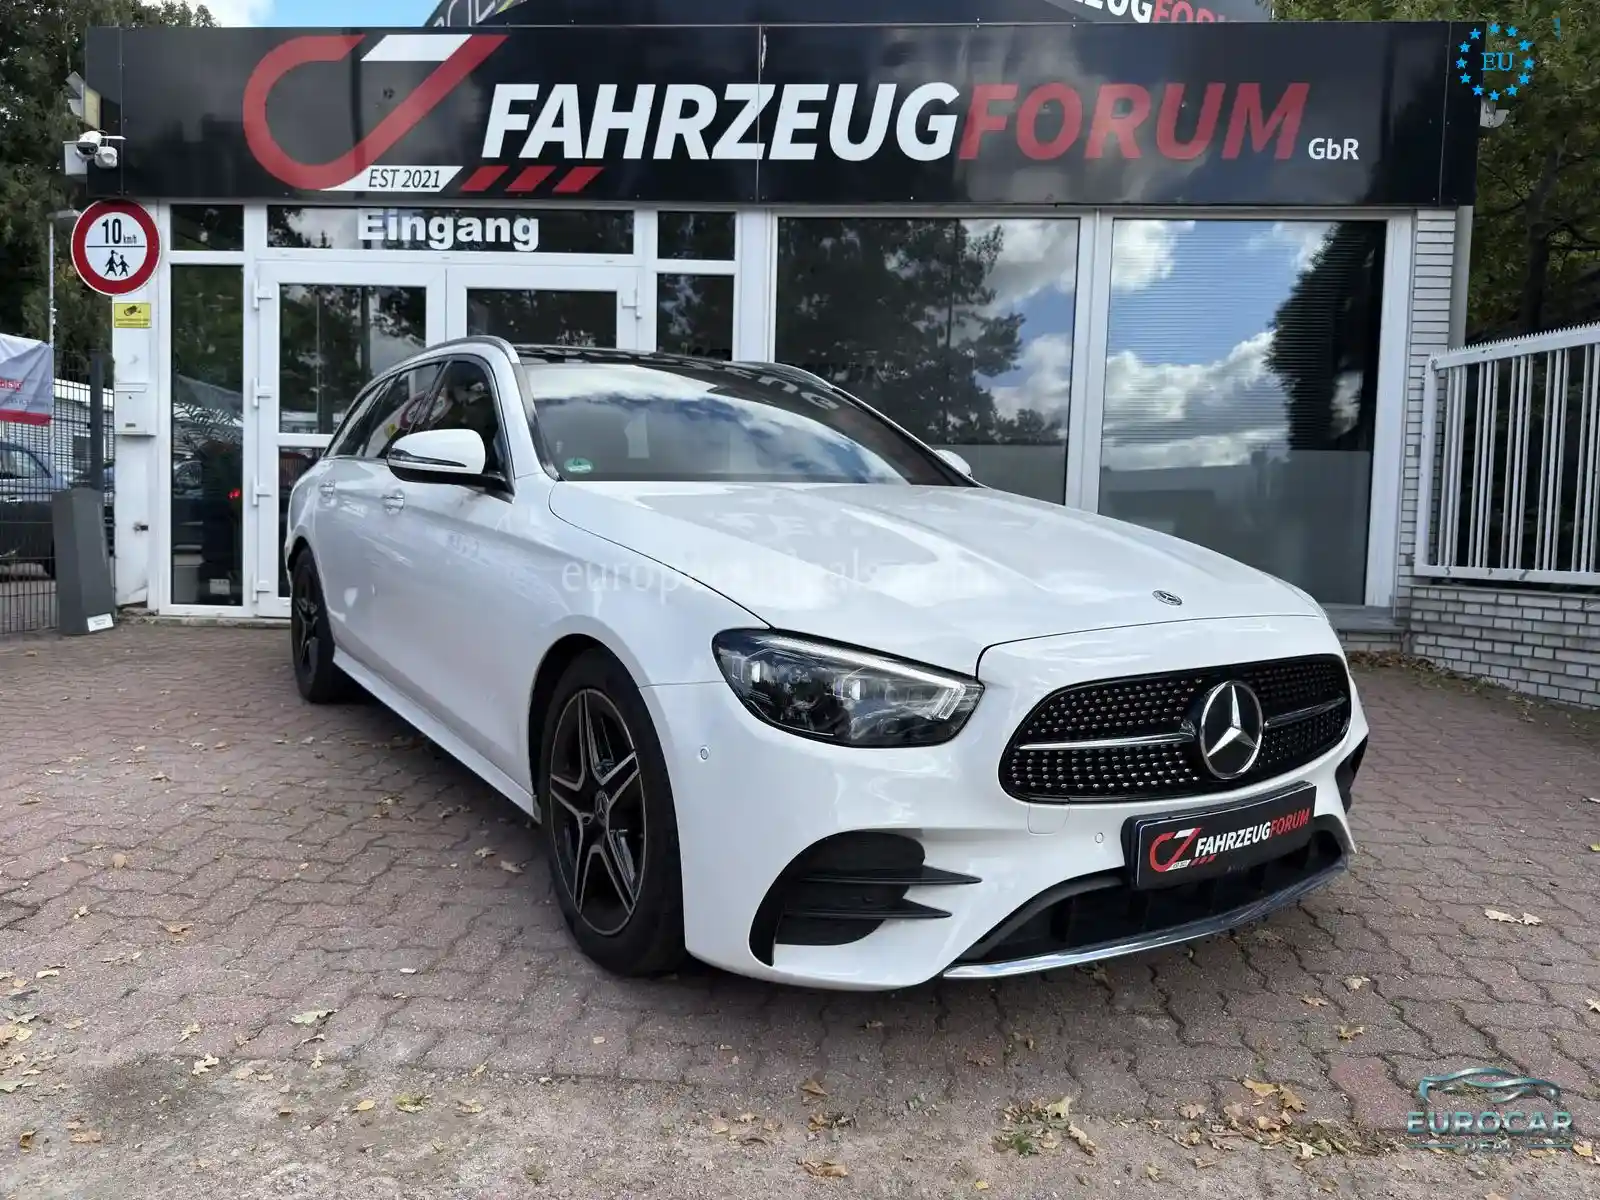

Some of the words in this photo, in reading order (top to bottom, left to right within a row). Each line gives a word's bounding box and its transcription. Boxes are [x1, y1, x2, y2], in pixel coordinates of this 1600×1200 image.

[1308, 138, 1360, 161] GbR
[368, 169, 400, 188] EST
[403, 169, 440, 188] 2021
[102, 219, 121, 244] 10
[357, 209, 539, 250] Eingang
